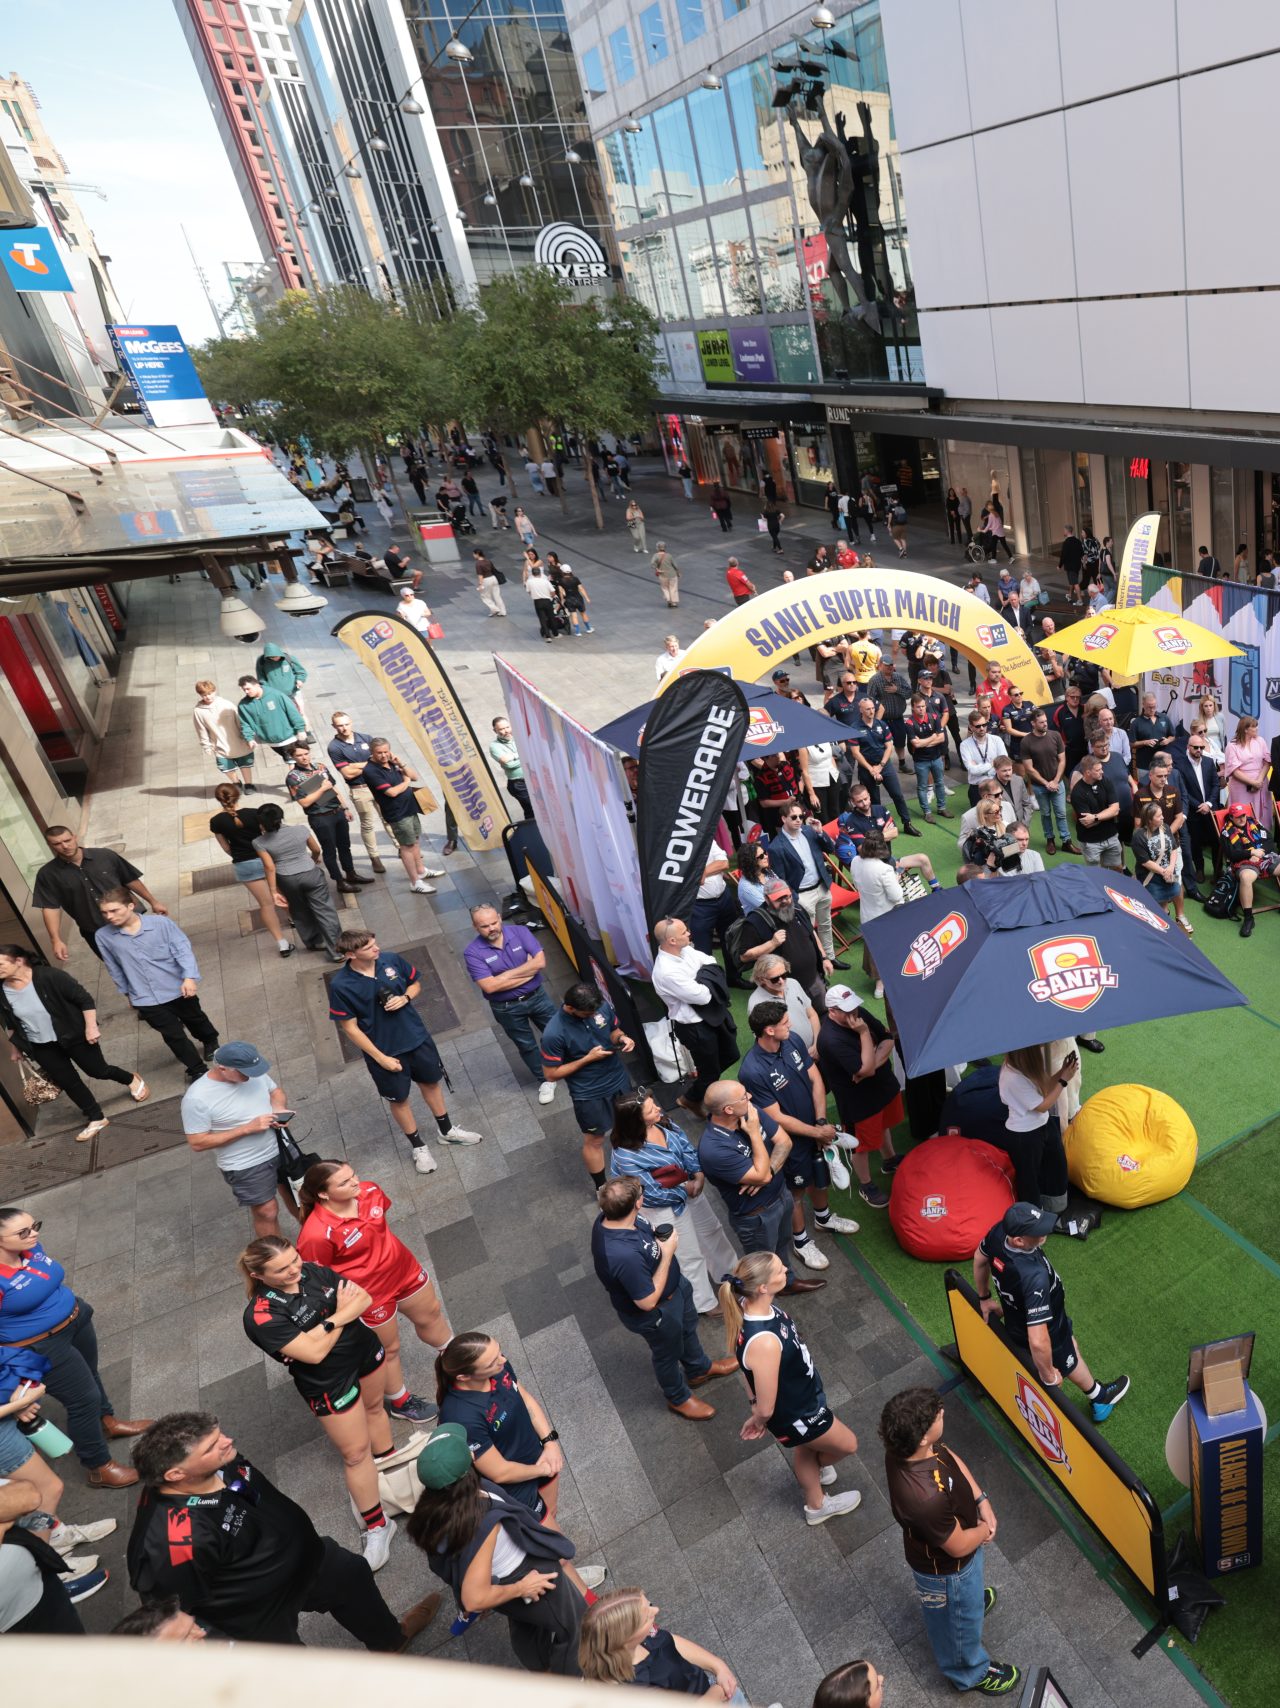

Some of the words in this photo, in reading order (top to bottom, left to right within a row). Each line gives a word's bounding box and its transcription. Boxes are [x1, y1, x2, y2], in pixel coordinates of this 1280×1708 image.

[746, 598, 824, 657] SANFL
[819, 588, 892, 626] SUPER
[895, 588, 962, 633] MATCH
[1082, 634, 1109, 649] SANFL
[1158, 638, 1193, 649] SANFL
[859, 650, 868, 664] 7
[744, 721, 784, 738] ANFL
[658, 705, 735, 883] POWERADE
[913, 933, 941, 980] SANFL
[1028, 966, 1118, 1002] SANFL
[921, 1206, 947, 1216] SANFL
[1015, 1394, 1073, 1475] SANFL
[1219, 1439, 1248, 1453] A
[1220, 1448, 1248, 1494] LEAGUE
[1221, 1489, 1248, 1506] OF
[1221, 1504, 1248, 1529] OUR
[1221, 1525, 1248, 1557] OWN
